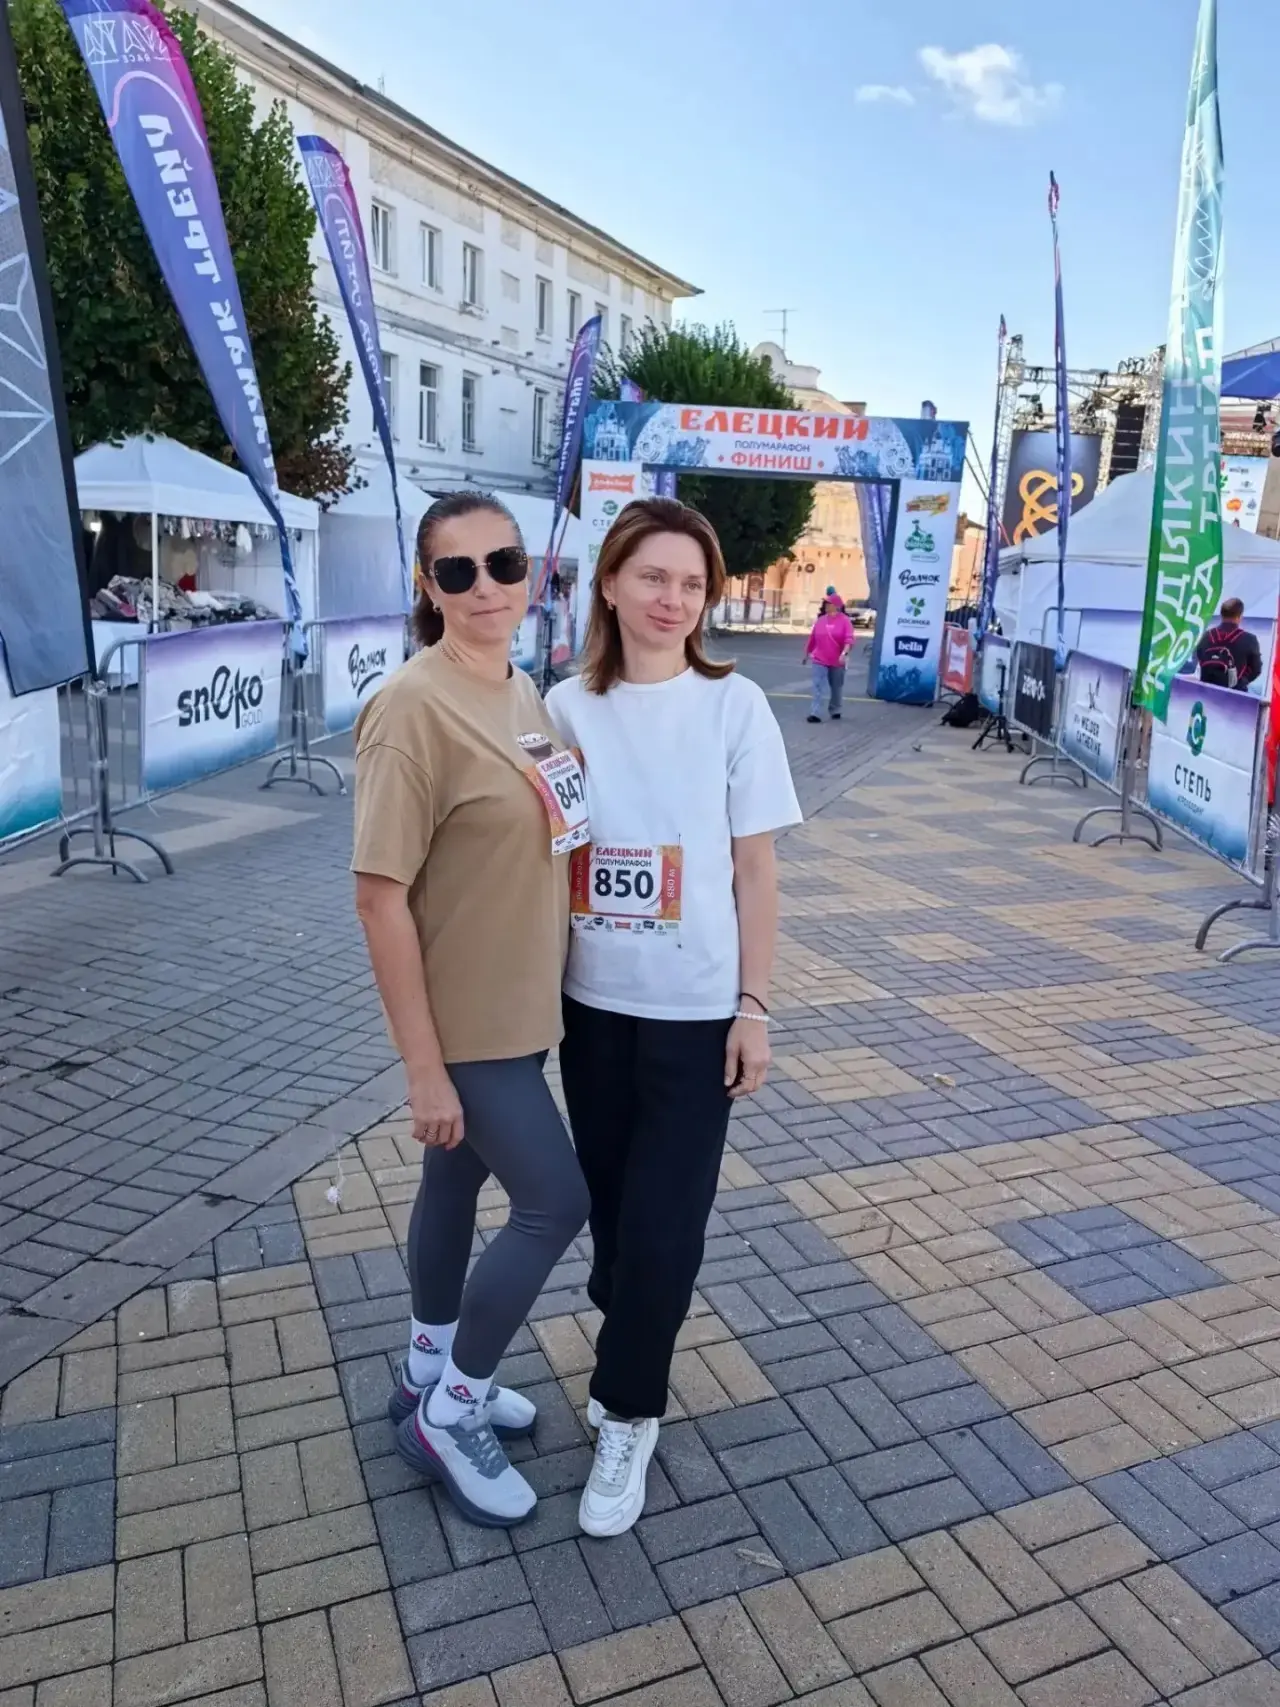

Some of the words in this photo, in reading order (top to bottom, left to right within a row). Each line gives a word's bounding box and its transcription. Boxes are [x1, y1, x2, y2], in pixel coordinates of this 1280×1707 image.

[734, 440, 811, 453] ПОЛУМАРАФОН
[731, 452, 813, 471] ФИНИШ
[1142, 372, 1196, 695] КУДЫКИН
[898, 640, 923, 652] bella
[241, 709, 263, 728] GOLD
[555, 772, 585, 810] 847
[1174, 764, 1212, 802] СТЕПЬ
[596, 846, 652, 858] ЕЛЕЦКИЙ
[595, 857, 652, 867] ПОЛУМАРАФОН
[594, 868, 654, 900] 850
[667, 879, 675, 898] 880
